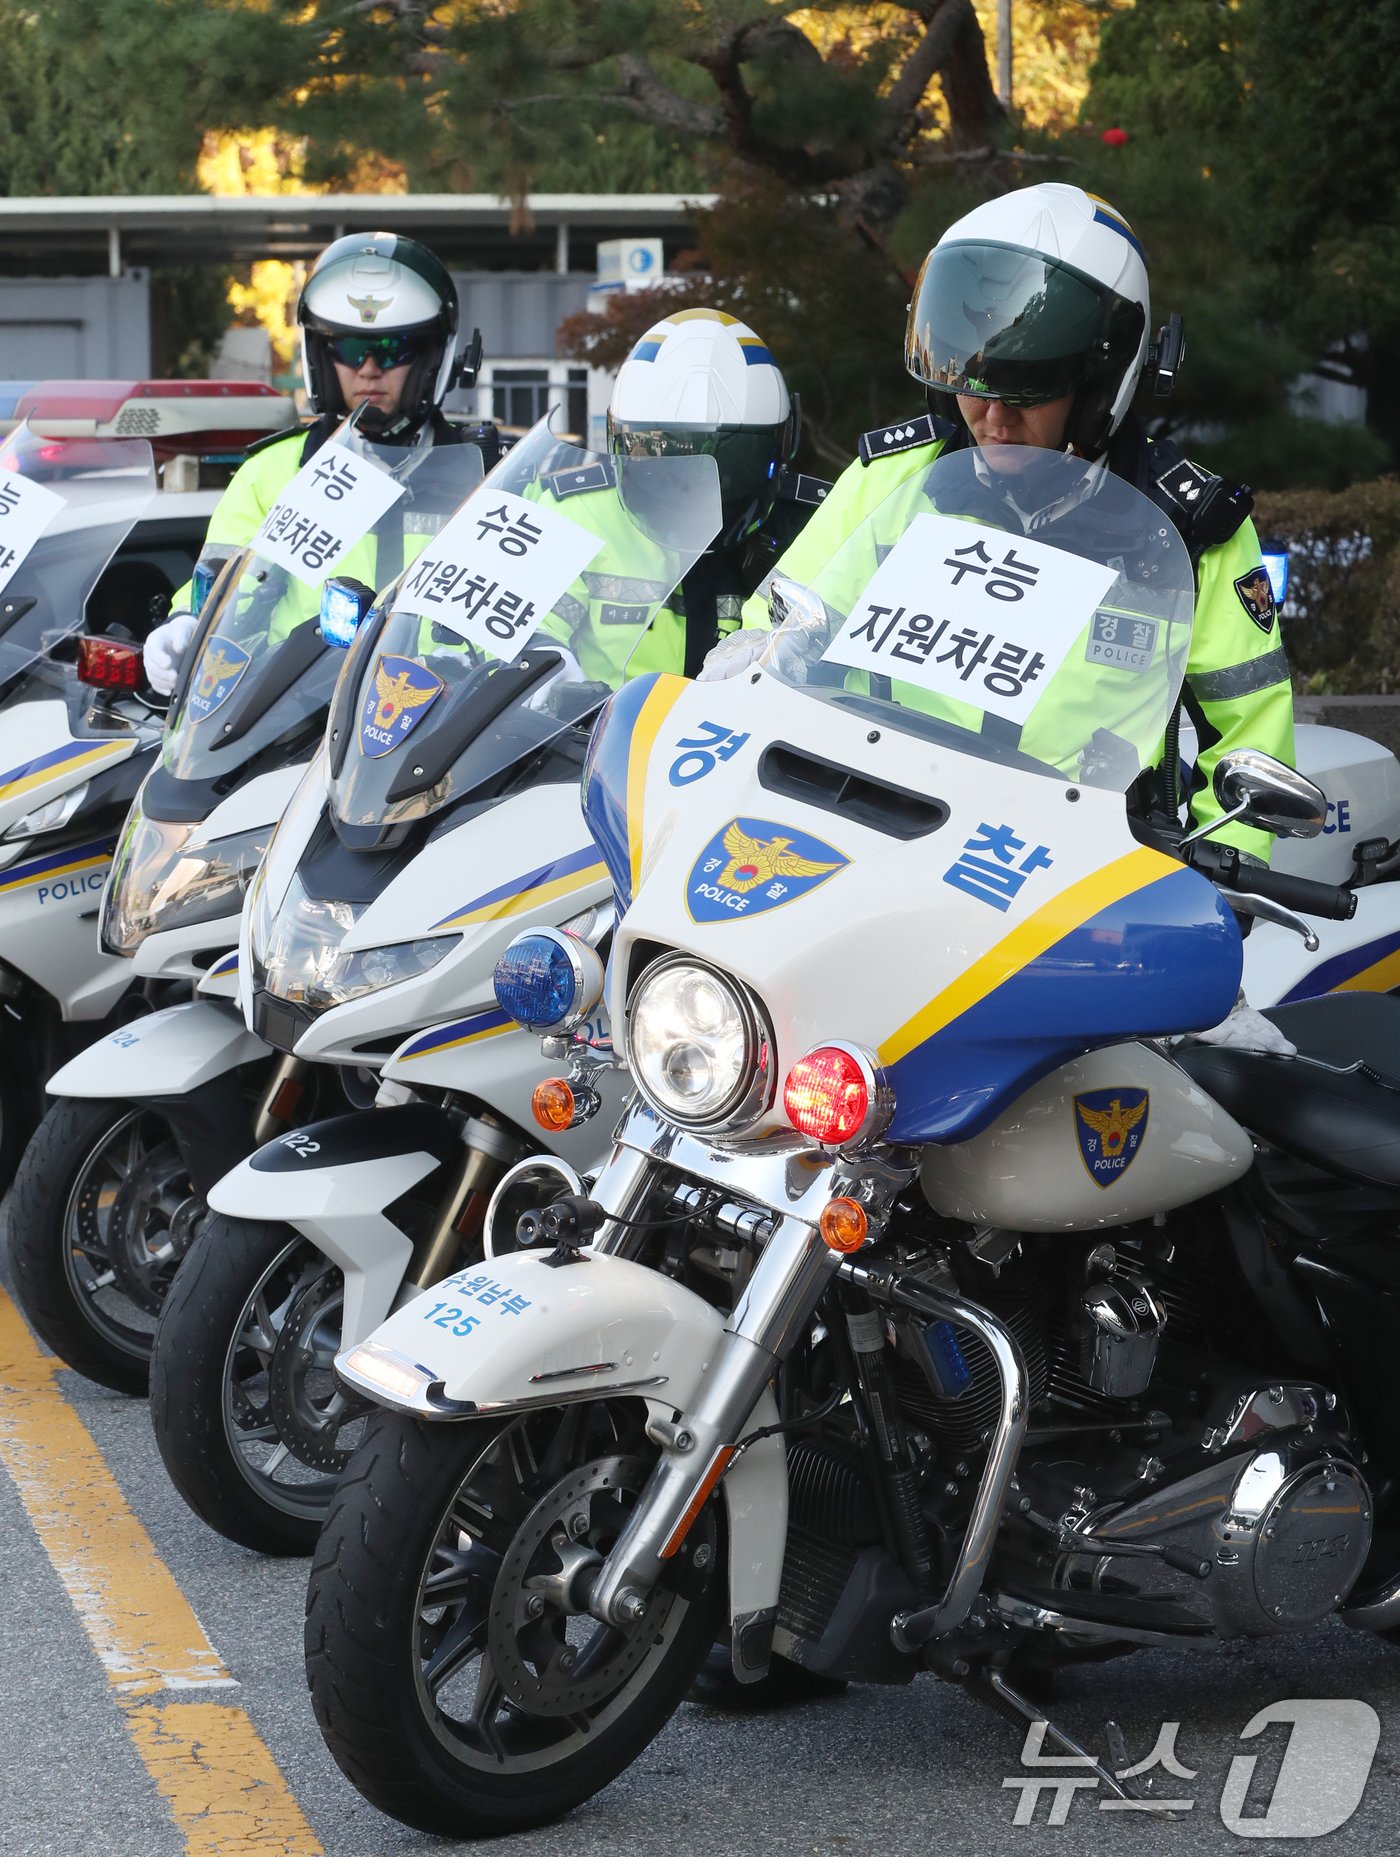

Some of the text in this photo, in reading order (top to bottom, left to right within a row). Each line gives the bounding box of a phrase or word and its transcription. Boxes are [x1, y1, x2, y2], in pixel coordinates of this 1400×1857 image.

[311, 455, 358, 501] 수능
[0, 482, 21, 516] 능
[261, 503, 344, 569] 지원차량
[476, 504, 543, 557] 수능
[943, 540, 1041, 602] 수능
[406, 560, 535, 640] 지원차량
[1099, 616, 1152, 650] 경 찰
[849, 604, 1047, 697] 지원차량
[1093, 645, 1146, 666] POLICE
[191, 694, 212, 711] POLICE
[367, 700, 412, 731] 경 찰
[363, 724, 394, 746] POLICE
[668, 720, 1055, 913] 경 찰
[38, 871, 111, 904] POLIC
[703, 857, 789, 900] 경 찰
[695, 883, 750, 912] POLICE
[107, 1030, 139, 1048] 124
[279, 1132, 321, 1158] 122
[1087, 1138, 1097, 1152] 경
[1094, 1157, 1126, 1170] POLICE
[442, 1272, 533, 1316] 수원남부
[423, 1302, 481, 1337] 125
